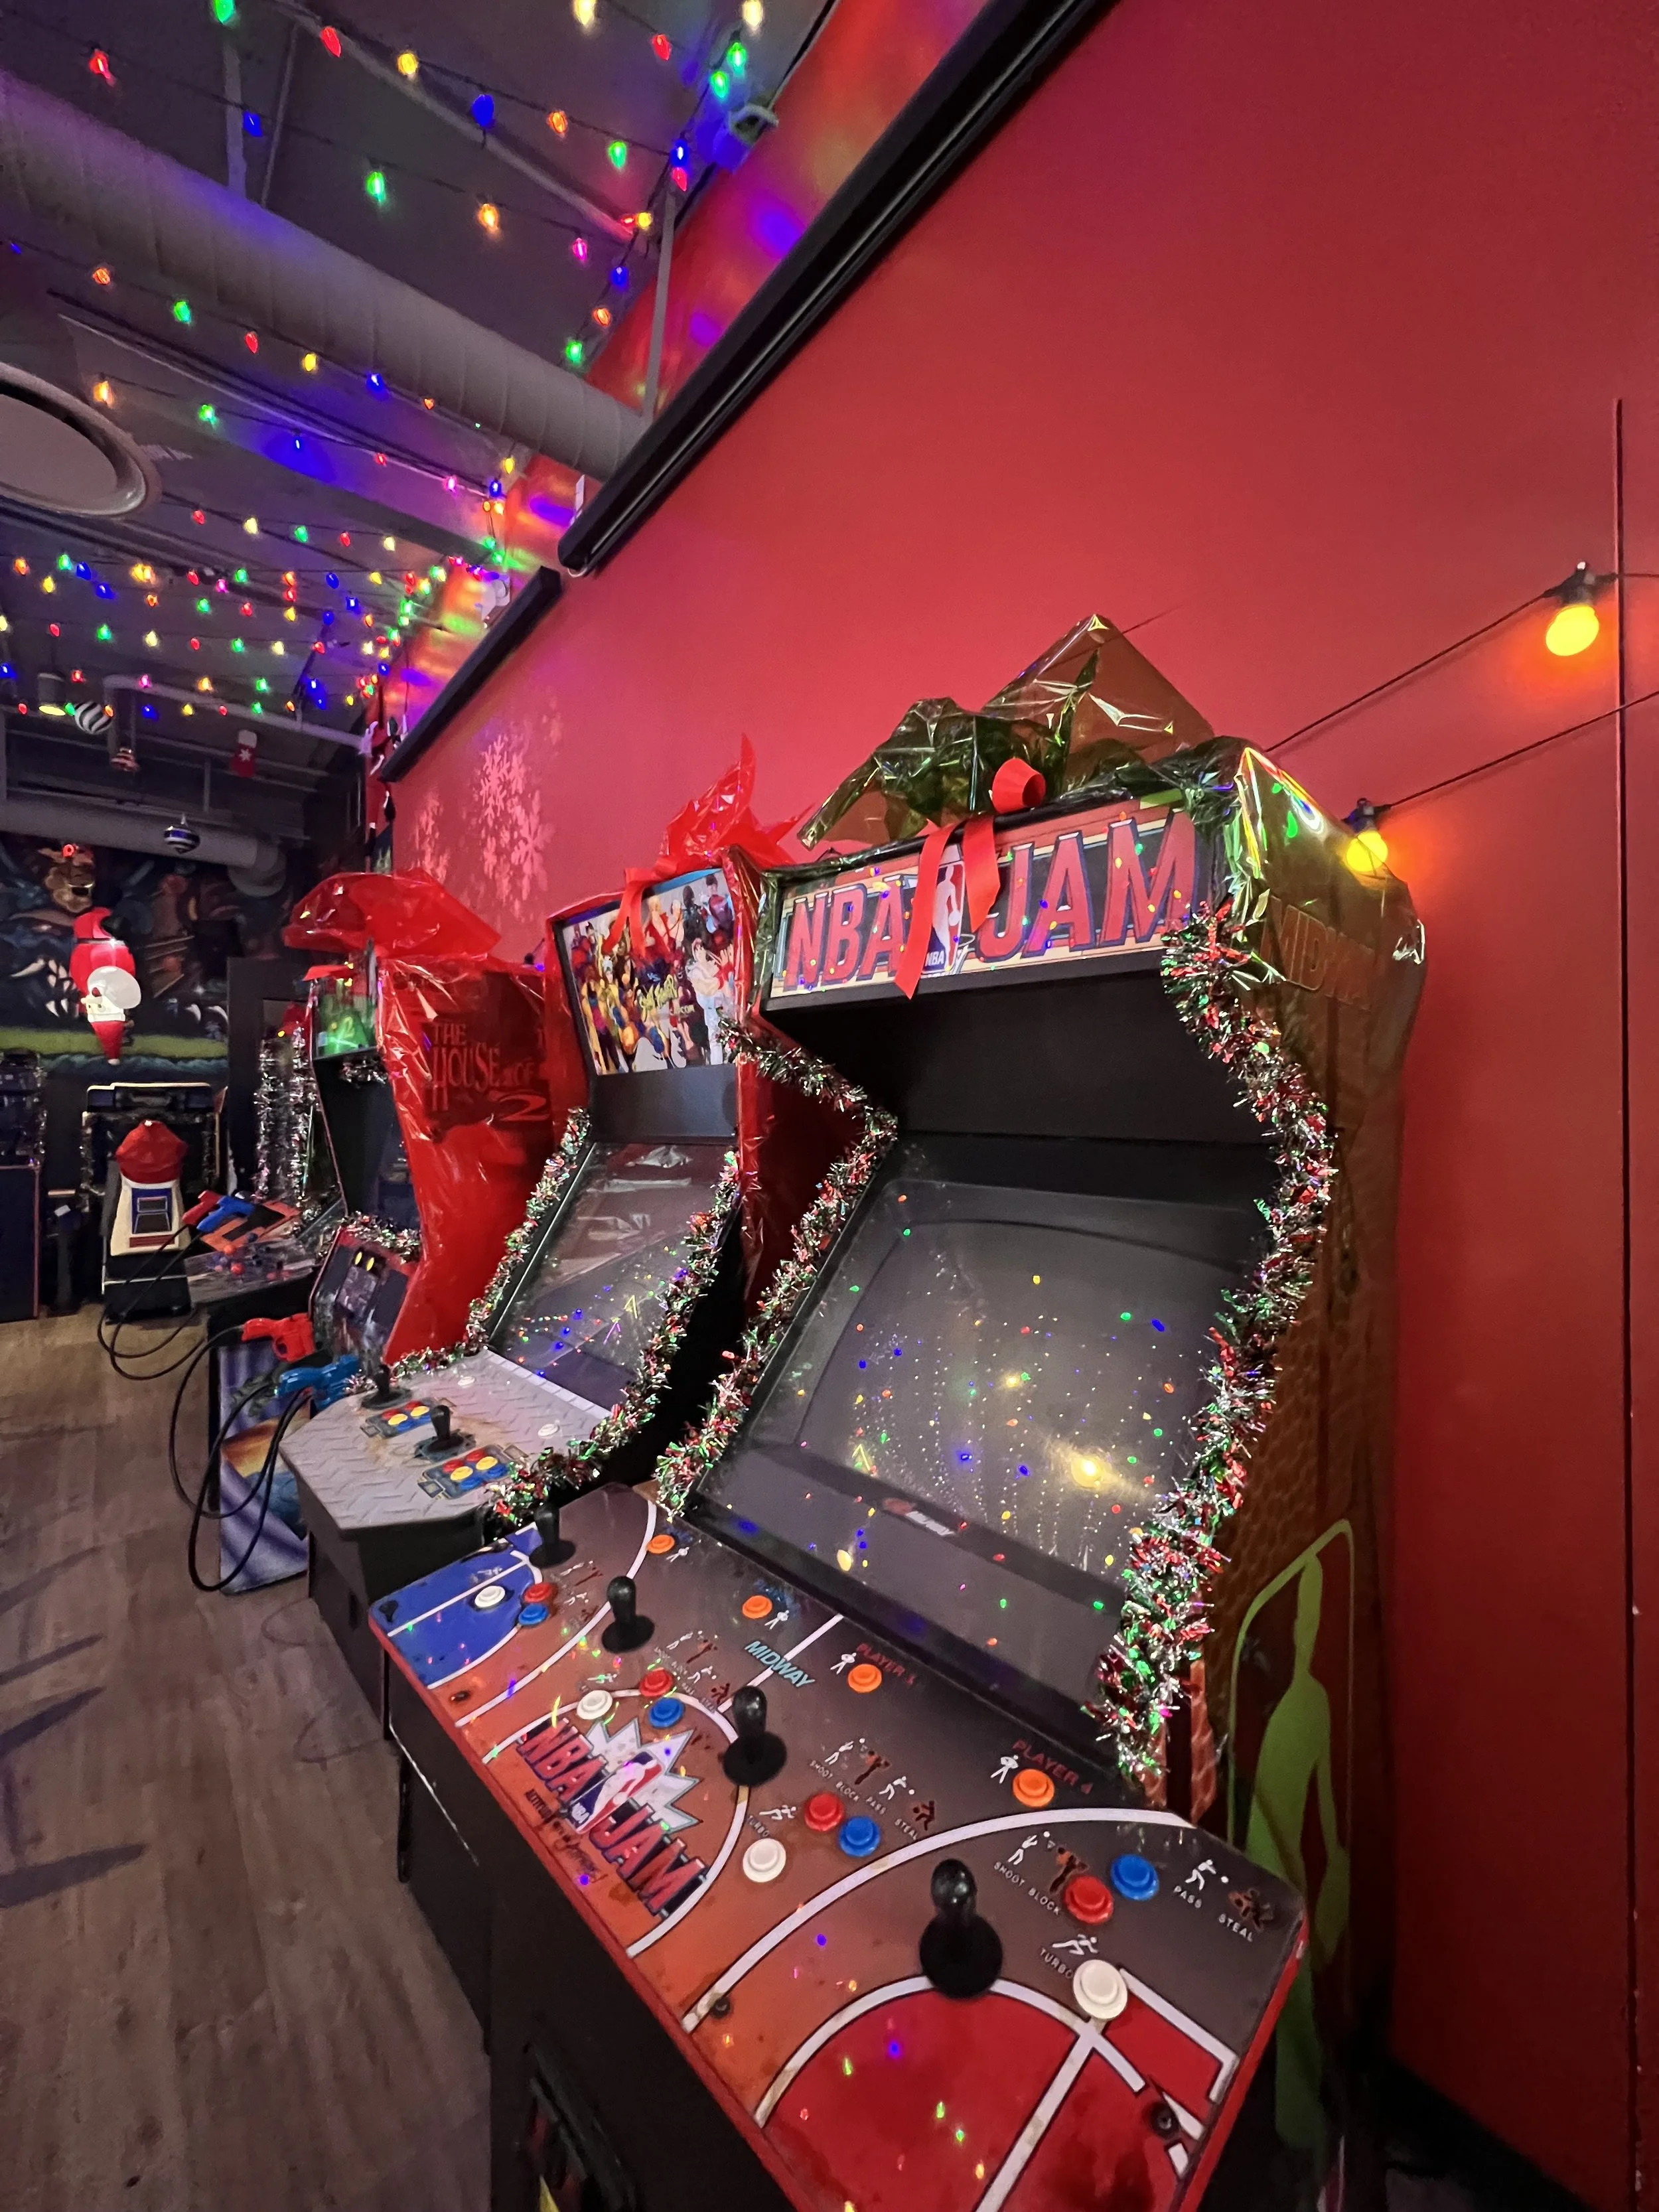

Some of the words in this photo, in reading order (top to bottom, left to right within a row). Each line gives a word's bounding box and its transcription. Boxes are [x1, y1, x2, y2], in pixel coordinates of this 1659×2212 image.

[784, 873, 906, 992] NBA
[975, 808, 1200, 961] JAM
[925, 950, 945, 967] NBA
[433, 1023, 467, 1046] THE
[432, 1042, 500, 1112] HOUSE
[498, 1092, 550, 1122] 2
[745, 1641, 816, 1688] MIDWAY
[856, 1643, 906, 1678] PLAYER
[809, 1759, 833, 1780] SHOOT
[835, 1781, 861, 1803] BLOCK
[1011, 1739, 1079, 1787] PLAYER
[516, 1718, 608, 1808] NBA
[589, 1803, 707, 1917] JAM
[865, 1796, 887, 1815] PASS
[894, 1818, 918, 1840] STEAL
[993, 1861, 1026, 1887] SHOOT
[1028, 1886, 1062, 1916] BLOCK
[1173, 1885, 1202, 1909] PASS
[1218, 1913, 1254, 1943] STEAL
[1040, 1947, 1074, 1979] TURBO
